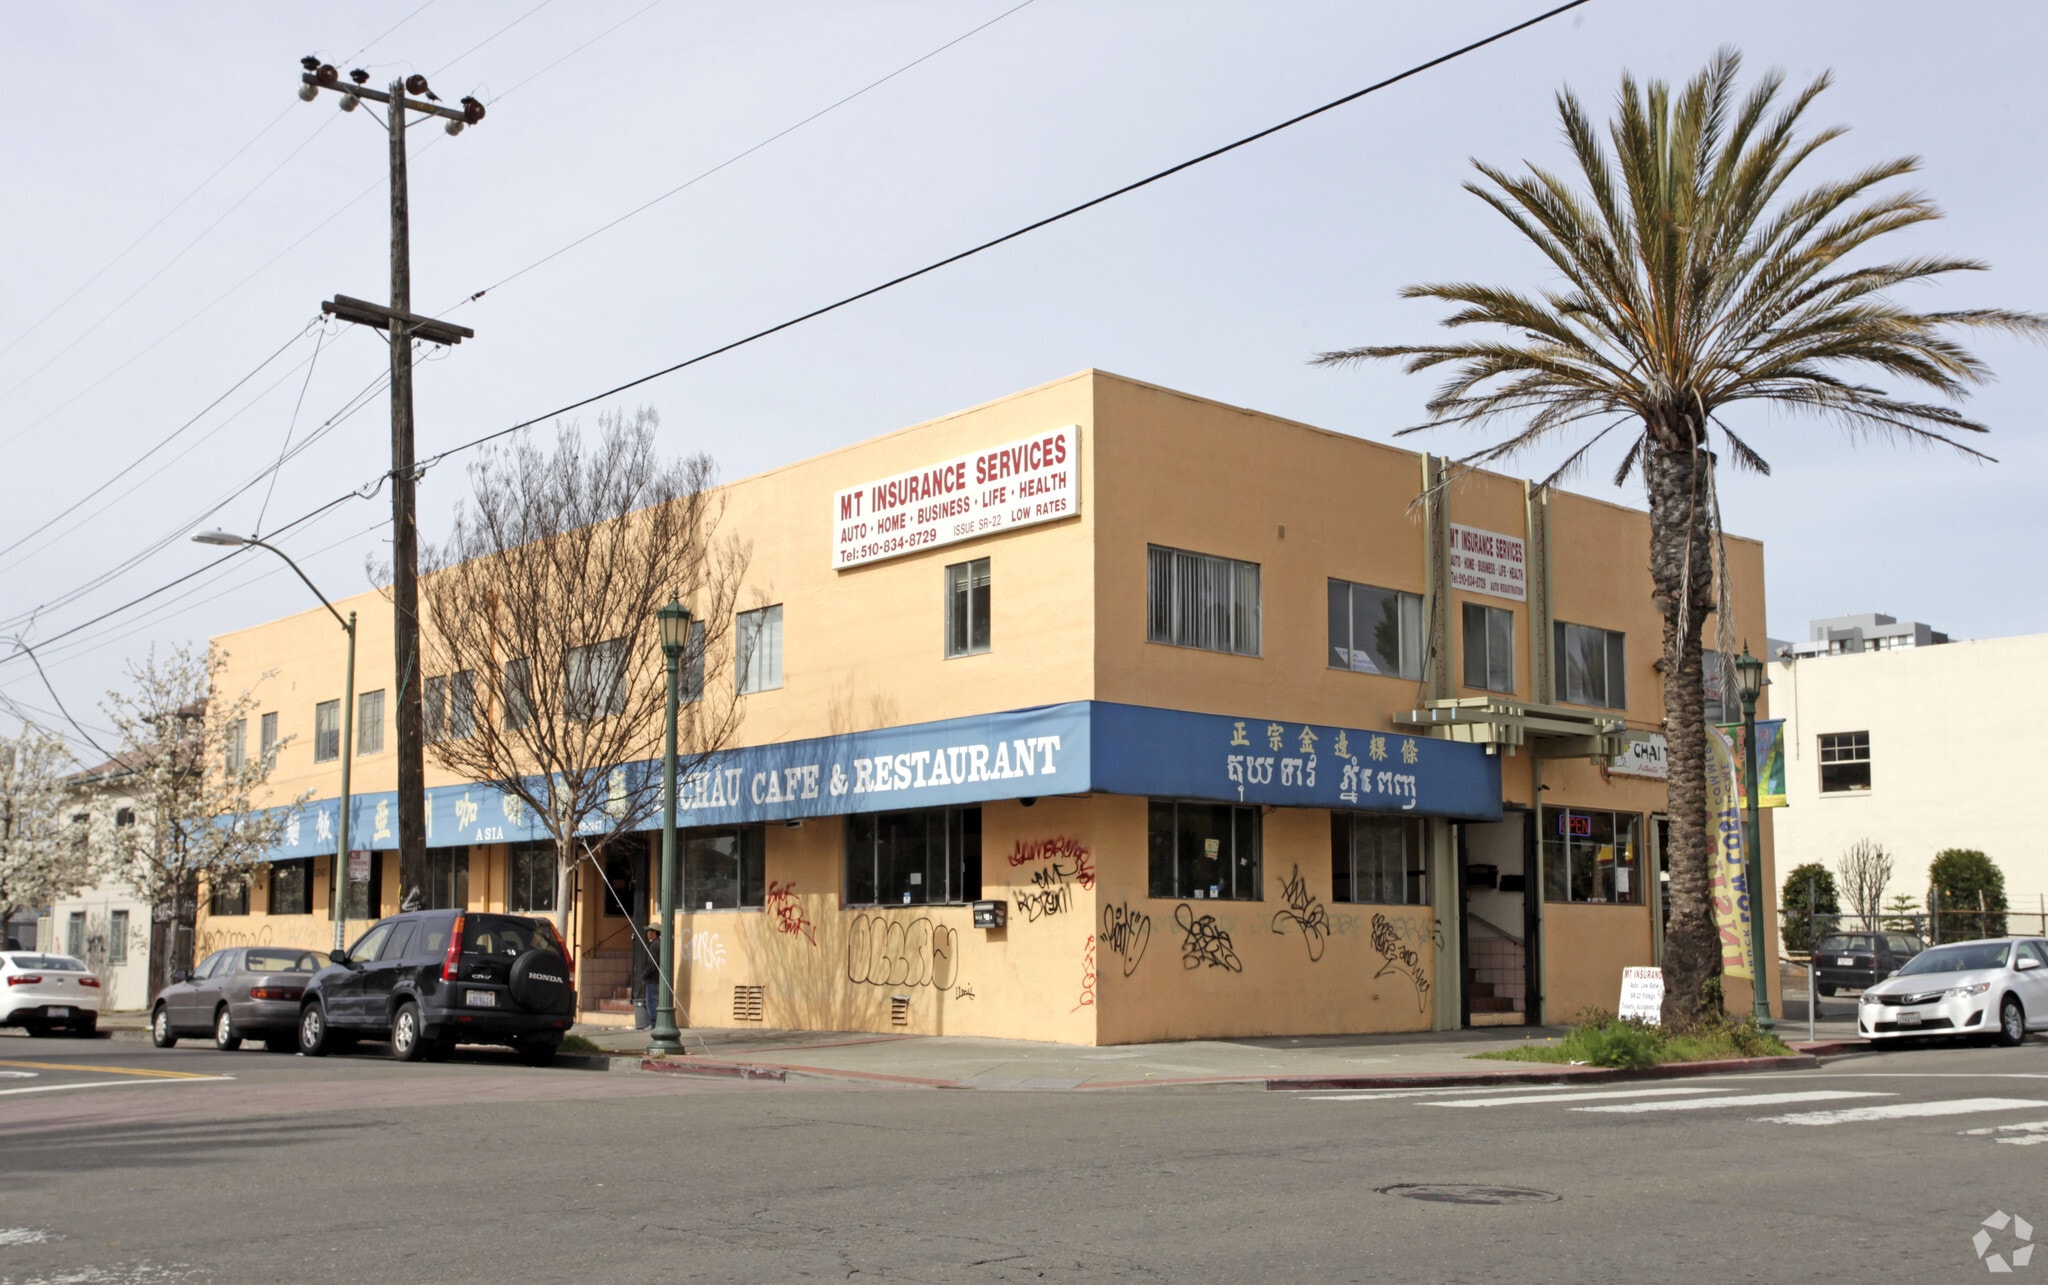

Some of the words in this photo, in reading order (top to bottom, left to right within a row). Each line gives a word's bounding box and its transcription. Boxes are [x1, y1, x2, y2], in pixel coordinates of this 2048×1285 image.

[841, 491, 863, 521] MT
[872, 462, 966, 513] INSURANCE
[976, 434, 1066, 485] SERVICES
[841, 523, 867, 544] AUTO
[877, 512, 906, 534] HOME
[917, 496, 970, 524] BUSINESS
[982, 486, 1006, 508] LIFE
[1019, 471, 1066, 499] HEALTH
[954, 521, 975, 537] ISSUE
[978, 515, 1001, 531] SR-22
[1011, 506, 1031, 522] LOW
[1036, 498, 1066, 516] RATES
[861, 528, 937, 558] 510-834-8729
[1450, 527, 1459, 549] MT
[1461, 530, 1494, 558] INSURANCE
[1495, 537, 1523, 563] SERVICES
[1451, 554, 1461, 568] AUTO
[1464, 557, 1475, 571] HOME
[1478, 560, 1496, 576] BUSINESS
[1498, 564, 1507, 578] LIFE
[1509, 567, 1523, 581] HEALTH
[1490, 582, 1499, 592] AUTO
[1500, 583, 1523, 596] REGISTRATION
[1634, 743, 1661, 763] CHAI
[751, 764, 820, 805] CAFE
[830, 763, 848, 797] &
[853, 735, 1061, 794] RESTAURANT
[475, 826, 504, 841] ASIA
[1561, 817, 1589, 834] OPEN
[528, 972, 563, 984] HONDA
[1624, 970, 1632, 978] MT
